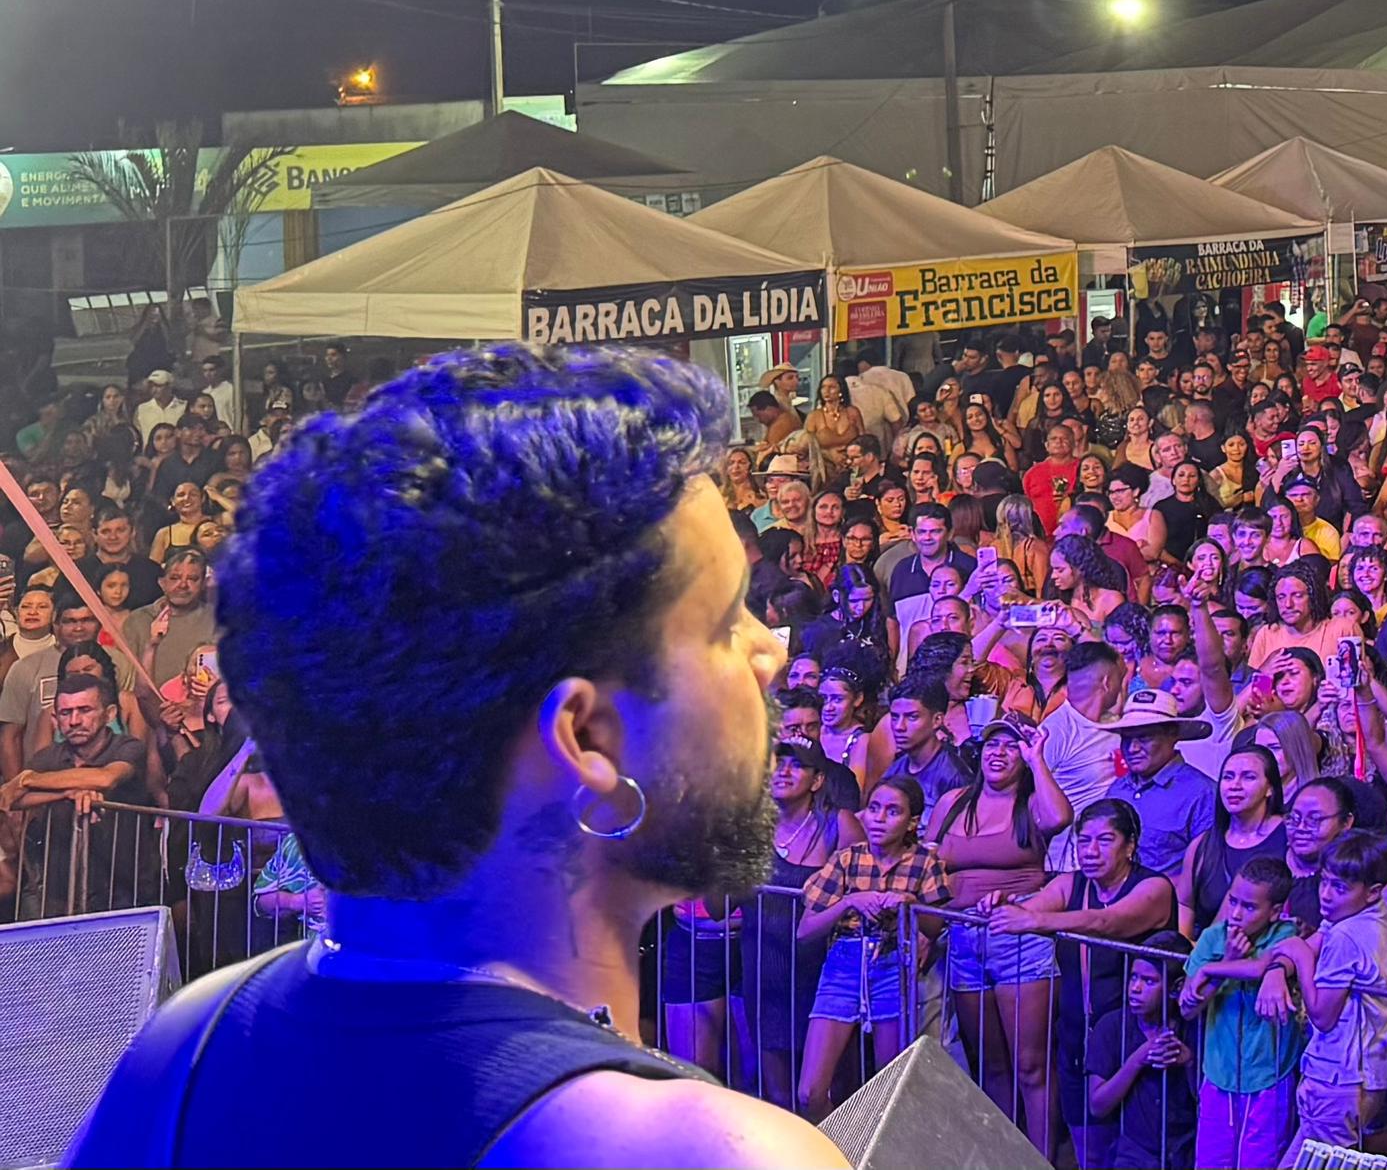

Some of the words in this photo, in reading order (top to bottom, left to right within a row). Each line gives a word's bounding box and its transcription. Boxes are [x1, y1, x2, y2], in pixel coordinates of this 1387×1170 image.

[20, 183, 48, 196] QUE
[21, 195, 30, 208] E
[1198, 241, 1247, 256] BARRACA
[1248, 239, 1265, 251] DA
[1185, 250, 1280, 274] RAIMUNDINHA
[919, 268, 1021, 296] Barraca
[1030, 259, 1060, 285] da
[1195, 267, 1271, 290] CACHOEIRA
[528, 296, 685, 345] BARRACA
[693, 292, 734, 332] DA
[742, 281, 820, 328] LÍDIA
[896, 286, 1073, 330] Francisca
